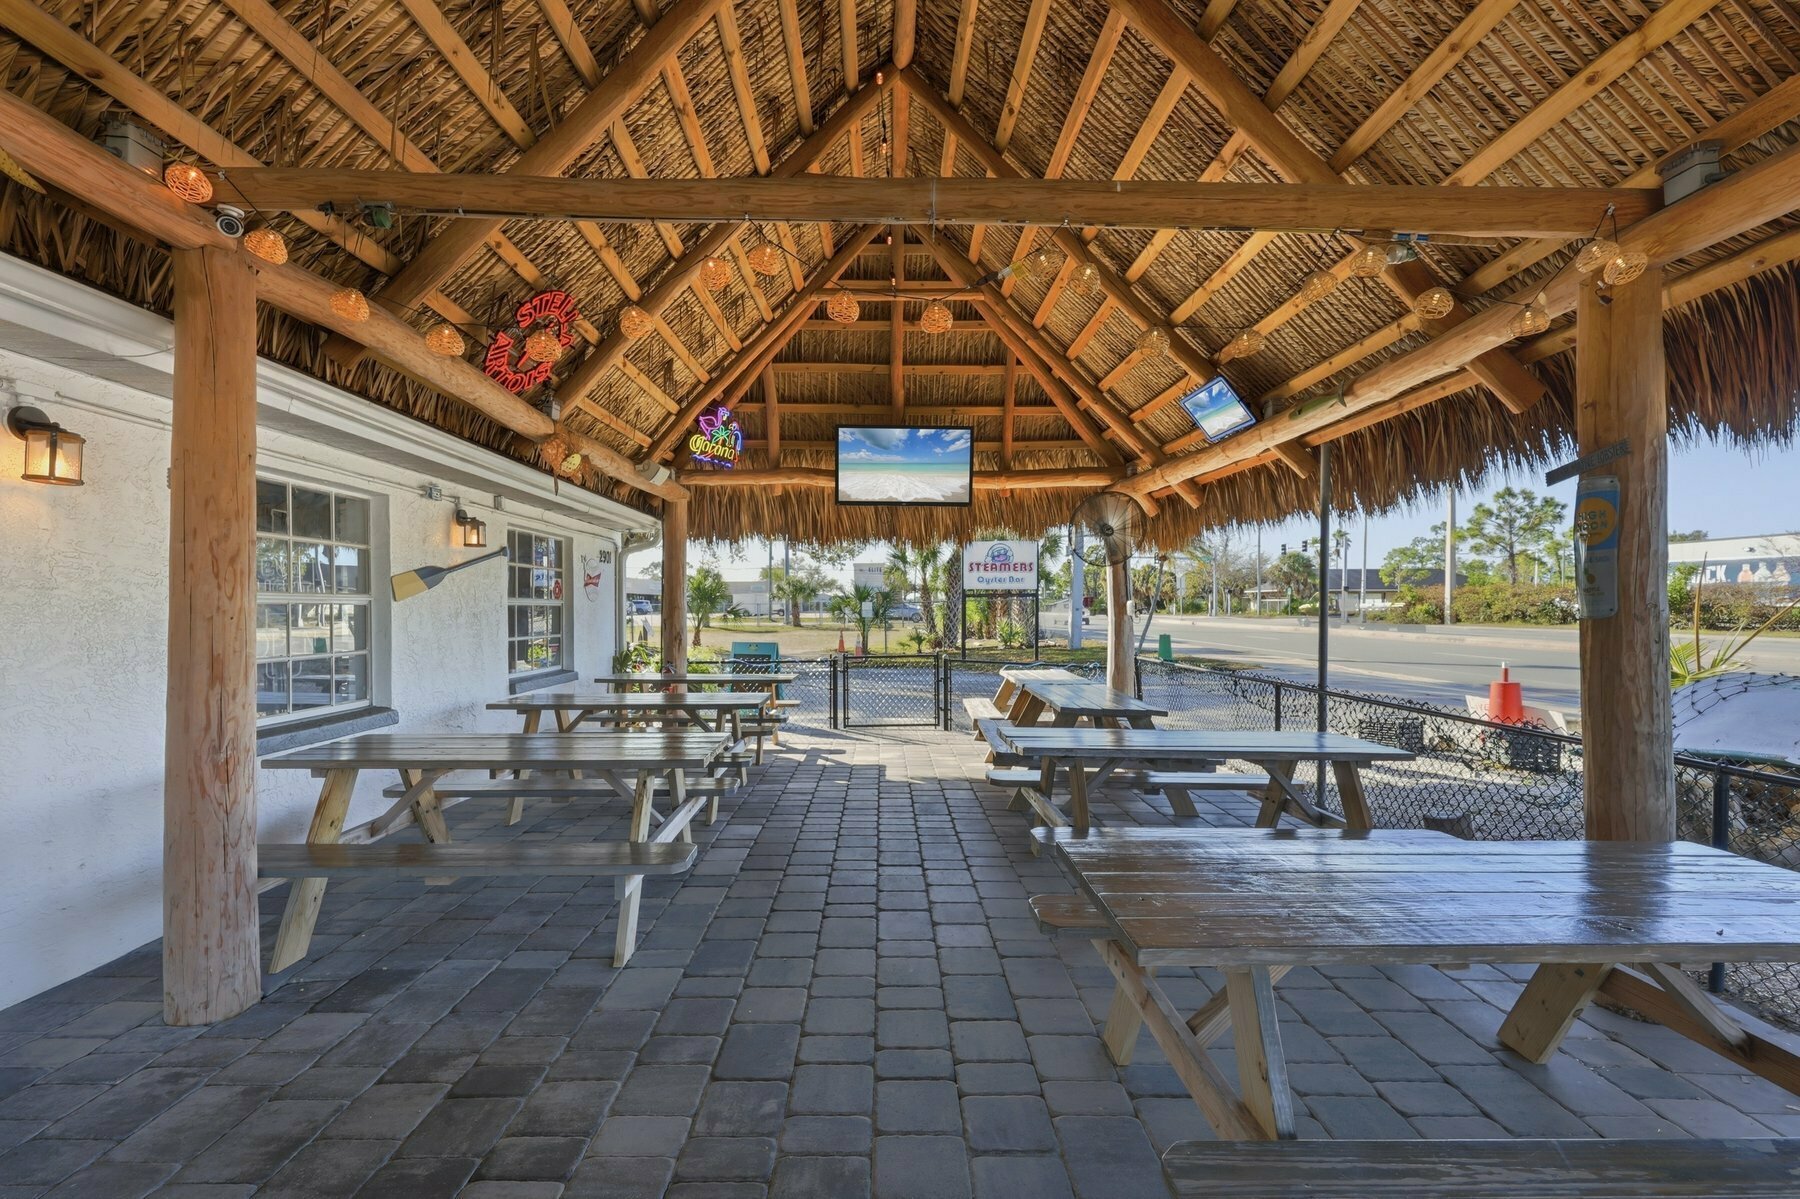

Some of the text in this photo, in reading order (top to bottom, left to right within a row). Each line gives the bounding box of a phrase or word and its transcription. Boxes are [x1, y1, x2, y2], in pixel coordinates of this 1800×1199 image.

[689, 434, 735, 460] Corona
[599, 549, 612, 564] 2901
[968, 562, 1034, 572] STEAMERS
[977, 575, 1025, 585] Oyster Bar
